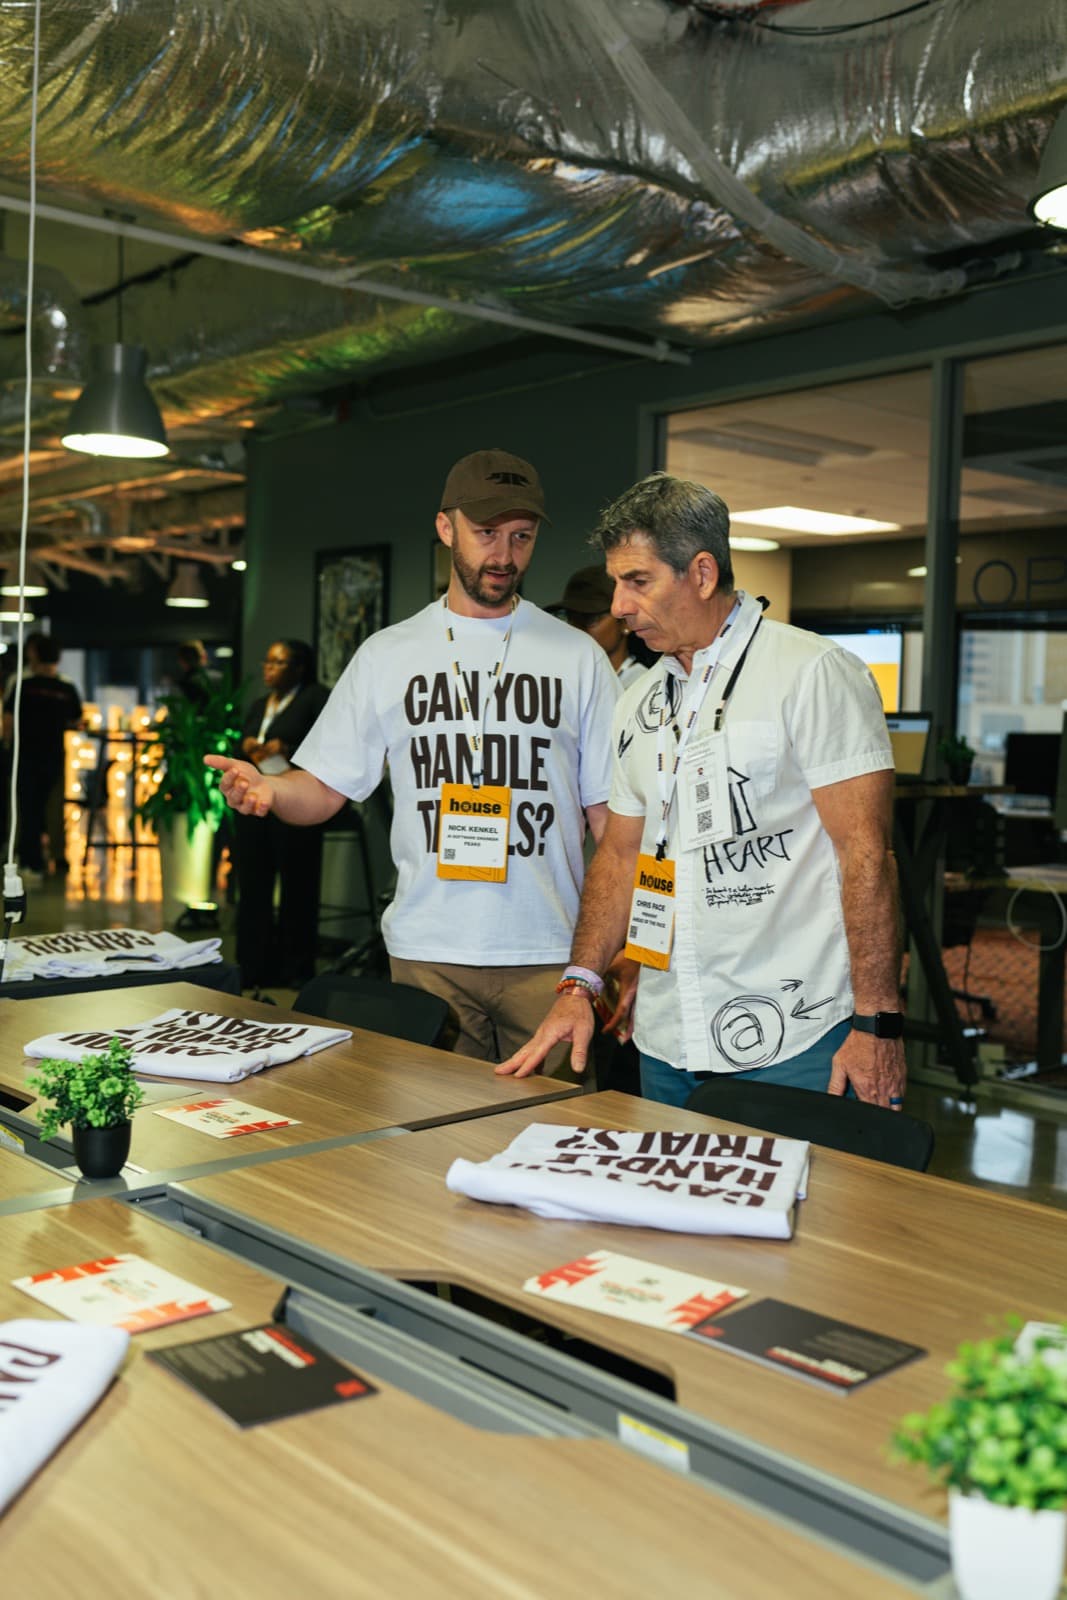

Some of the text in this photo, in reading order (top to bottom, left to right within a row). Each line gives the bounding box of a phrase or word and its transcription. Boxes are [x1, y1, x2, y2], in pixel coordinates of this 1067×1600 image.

[404, 671, 562, 729] CAN YOU
[410, 733, 552, 792] HANDLE
[450, 799, 501, 814] house
[704, 828, 794, 883] HEART
[639, 871, 673, 893] house
[637, 900, 665, 911] CHRIS PACE
[554, 1127, 783, 1167] TRIALS?
